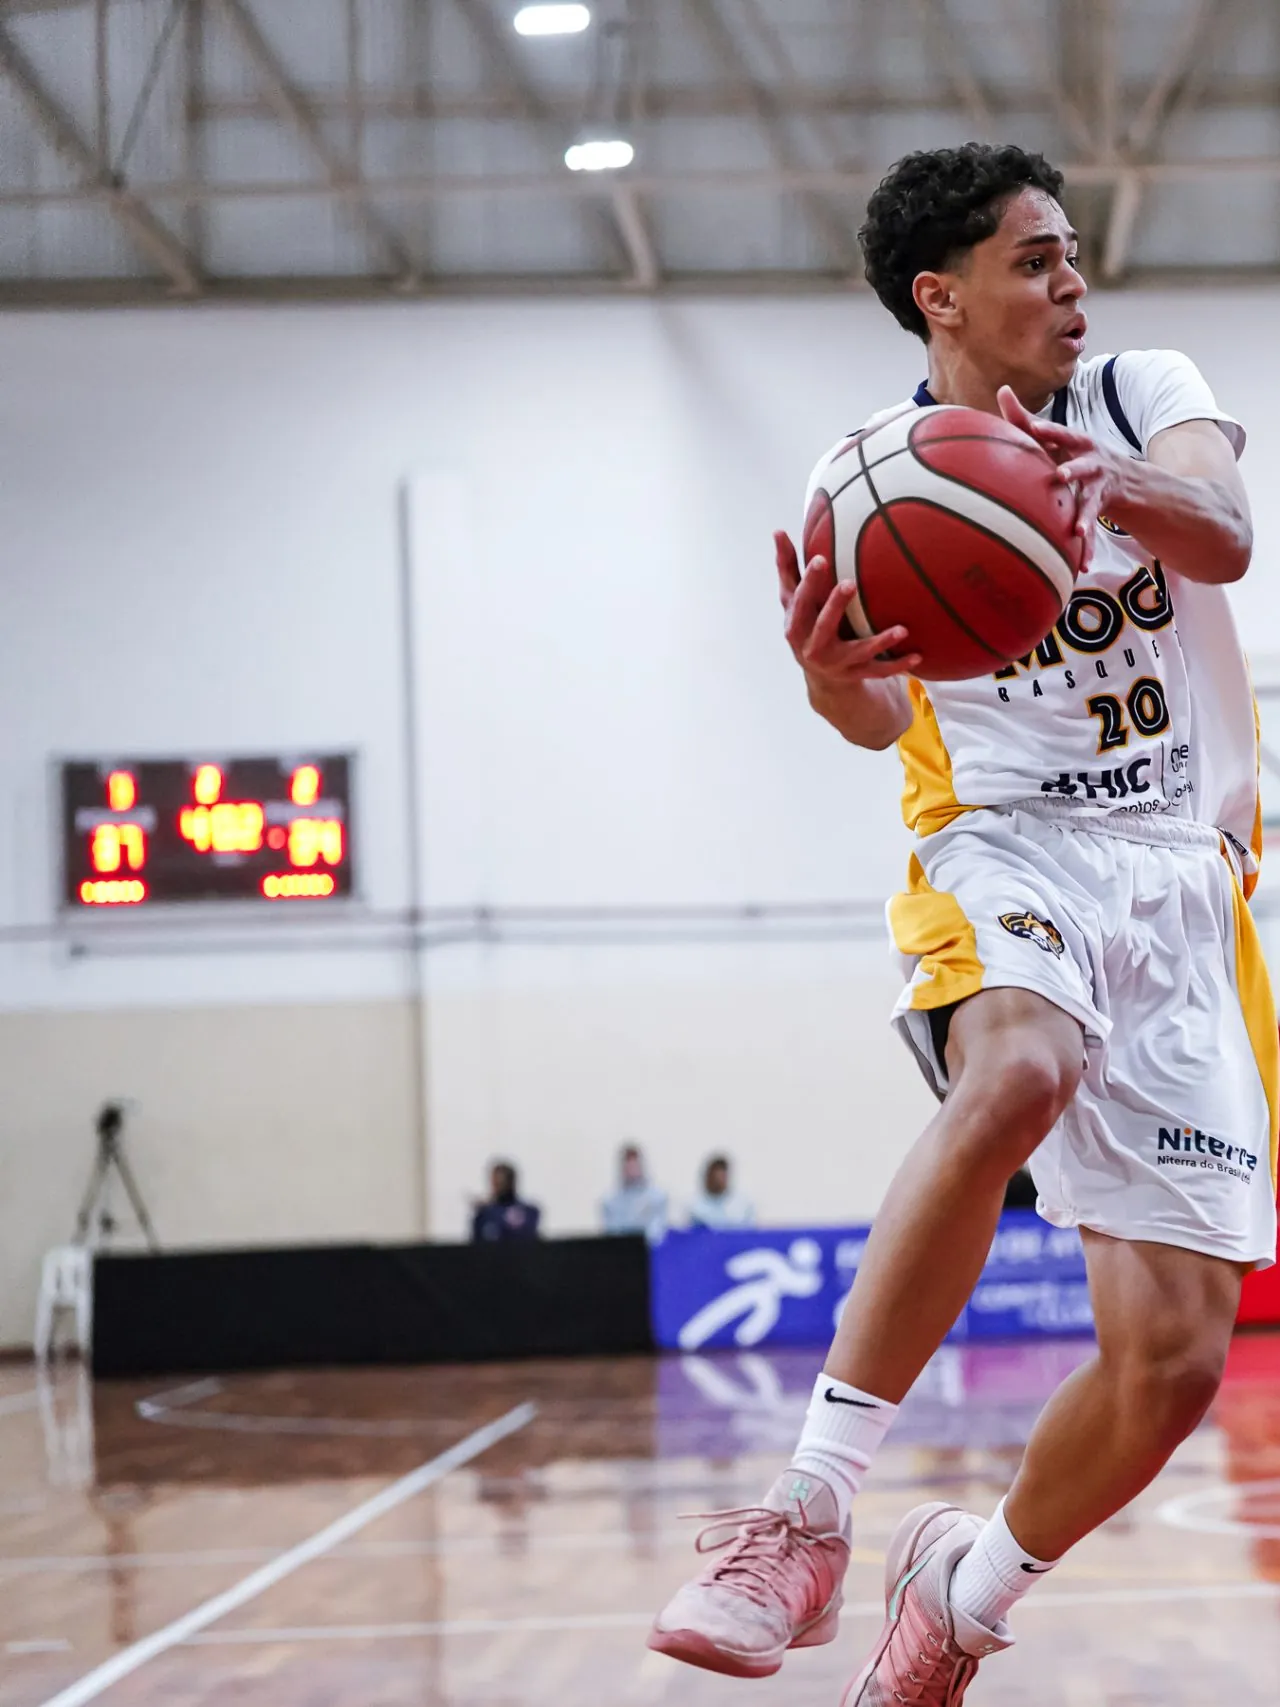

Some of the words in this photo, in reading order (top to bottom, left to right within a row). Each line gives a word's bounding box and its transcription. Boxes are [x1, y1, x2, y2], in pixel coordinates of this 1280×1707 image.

[1085, 675, 1171, 755] 20
[1157, 1155, 1197, 1168] Niterra
[1200, 1159, 1214, 1170] do
[1158, 1127, 1258, 1171] Niterra
